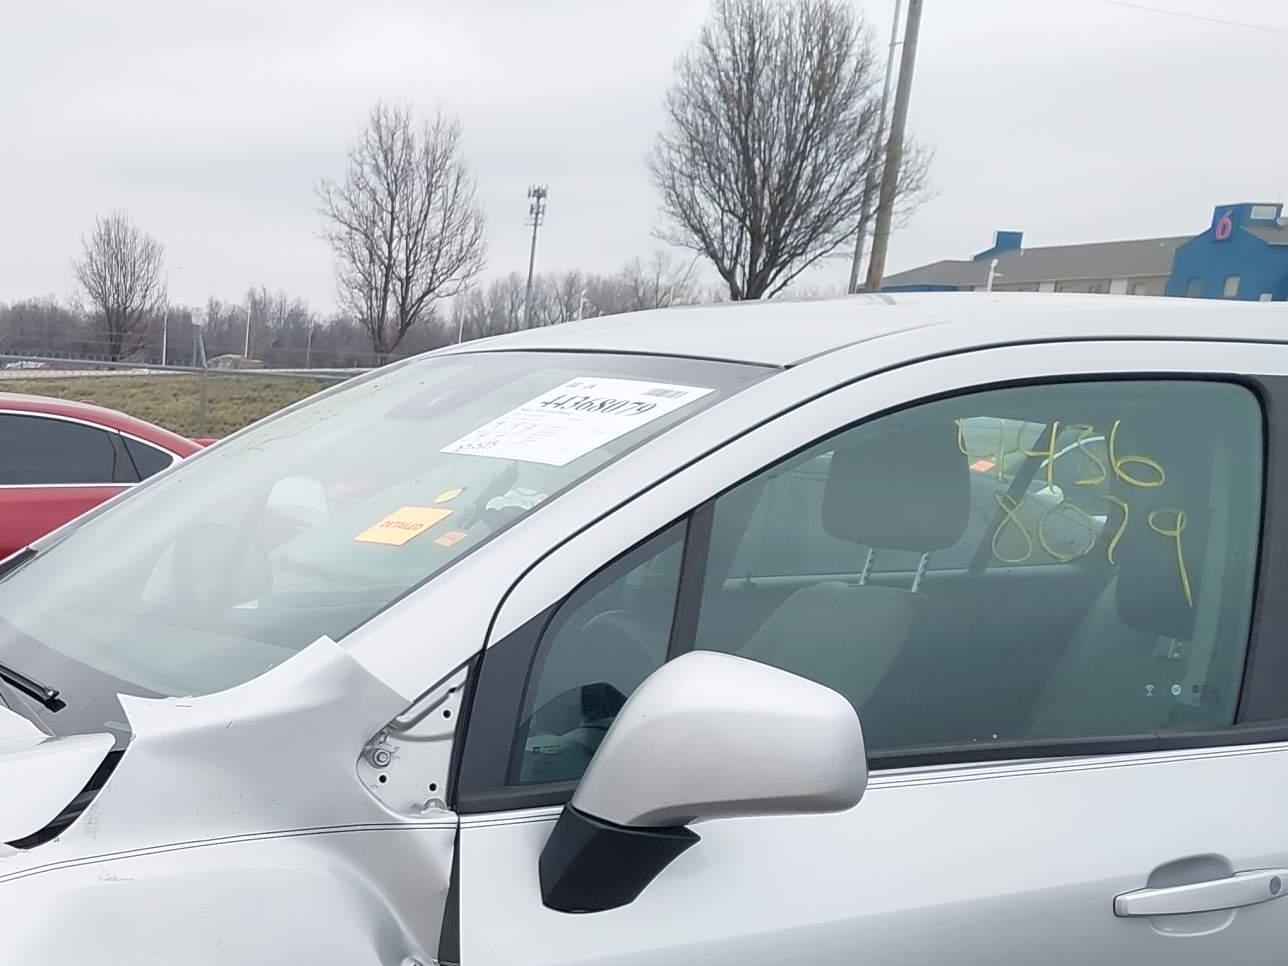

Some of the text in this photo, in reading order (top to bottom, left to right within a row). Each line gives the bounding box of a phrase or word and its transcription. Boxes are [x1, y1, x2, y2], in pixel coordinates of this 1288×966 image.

[1215, 209, 1233, 241] 6
[540, 393, 657, 417] 44368079
[992, 493, 1193, 608] 8079
